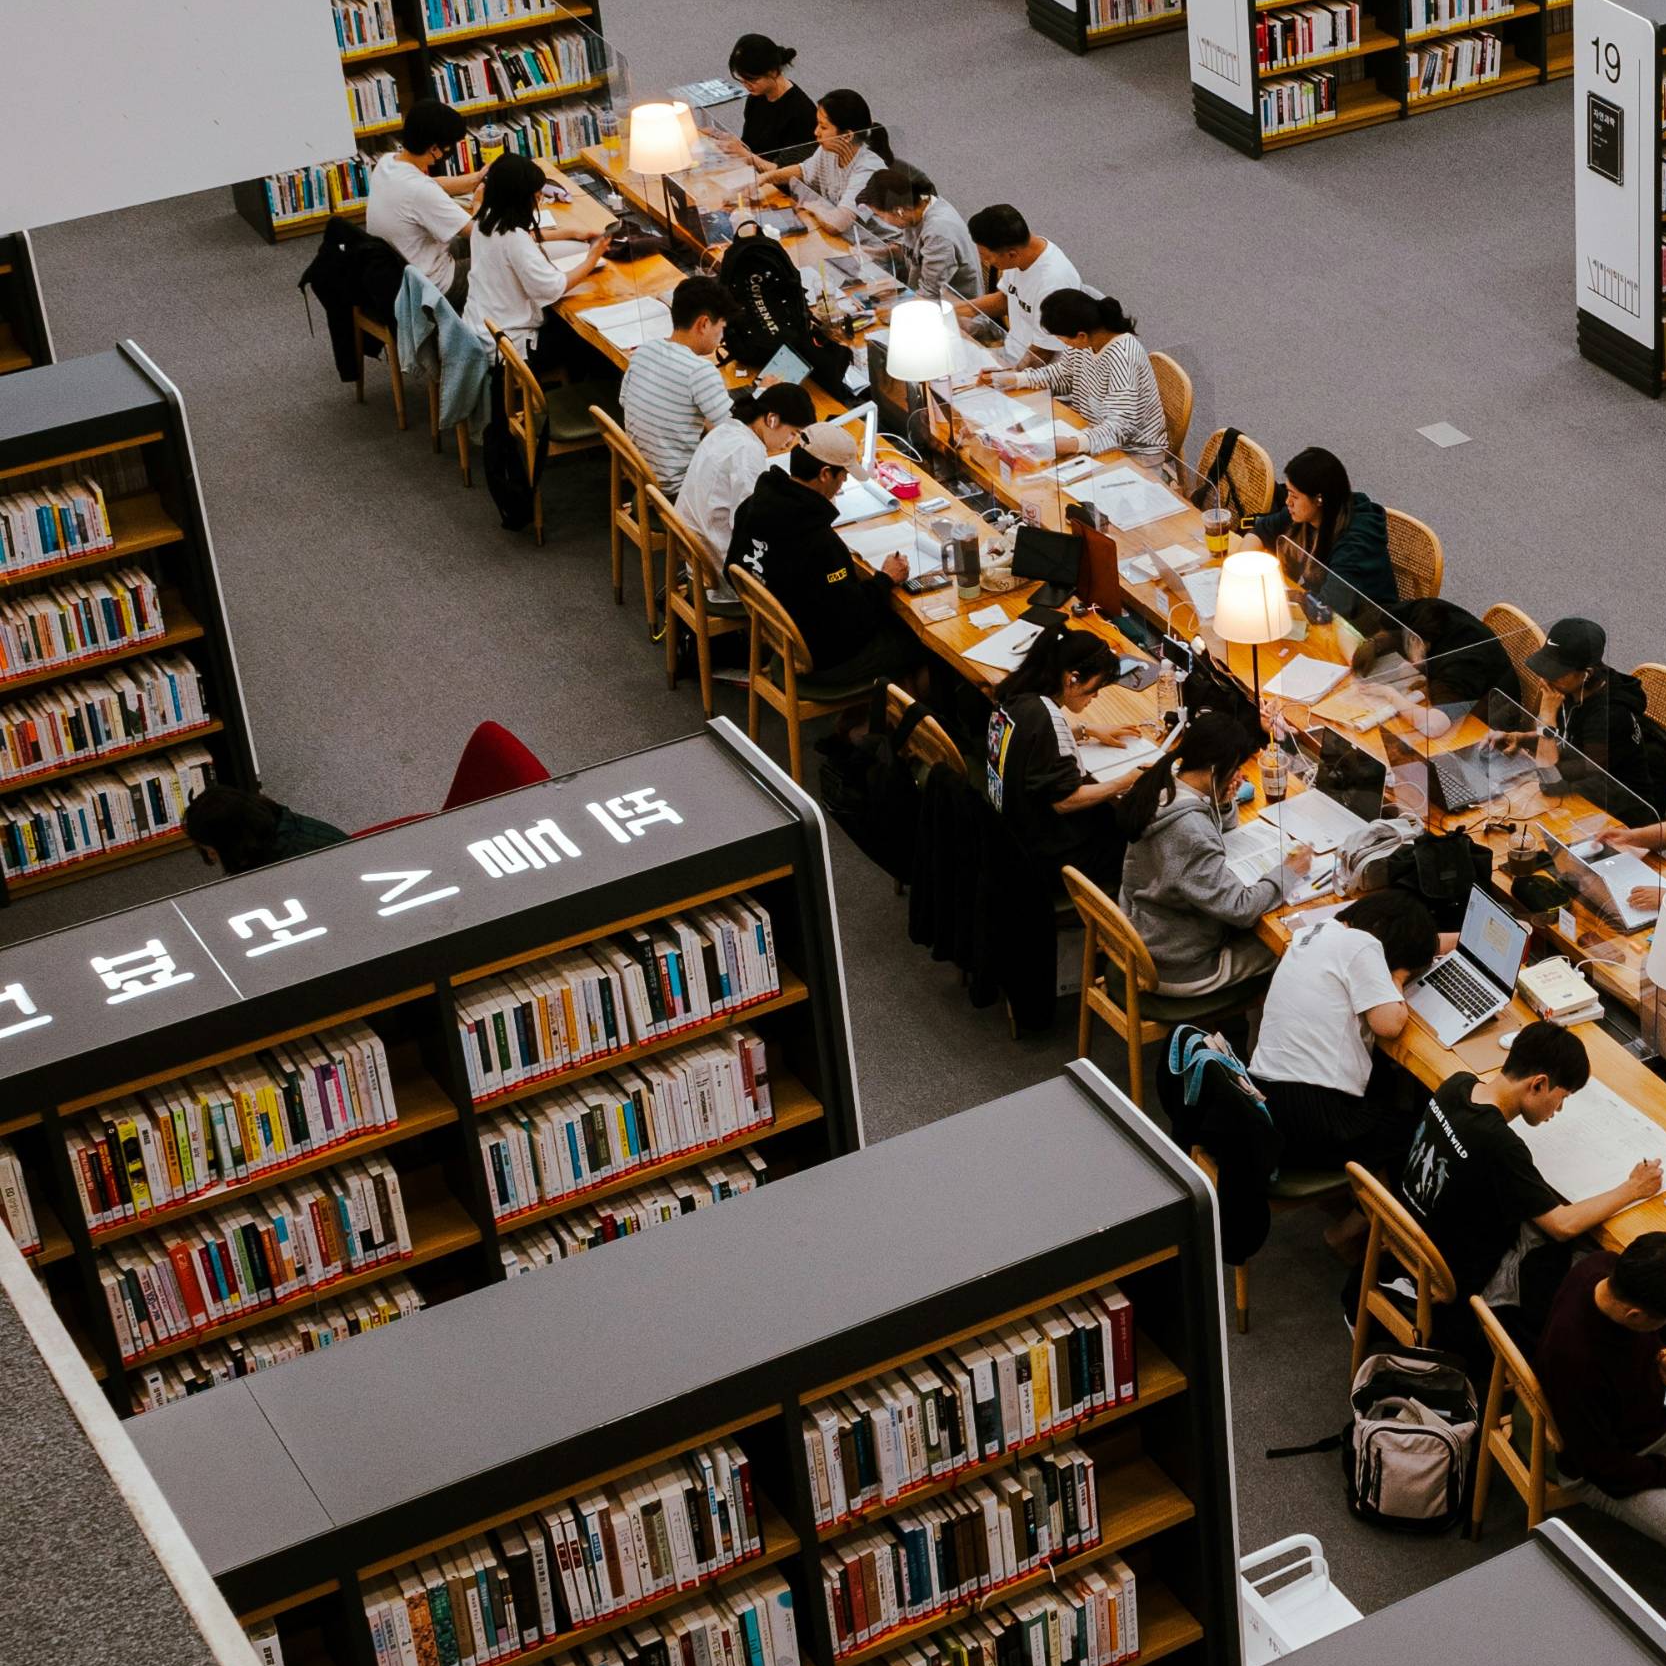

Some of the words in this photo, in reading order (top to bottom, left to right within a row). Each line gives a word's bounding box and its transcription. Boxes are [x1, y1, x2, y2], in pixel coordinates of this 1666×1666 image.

[1591, 35, 1622, 85] 19
[1441, 1118, 1455, 1138] THE
[1449, 1134, 1469, 1160] WILD
